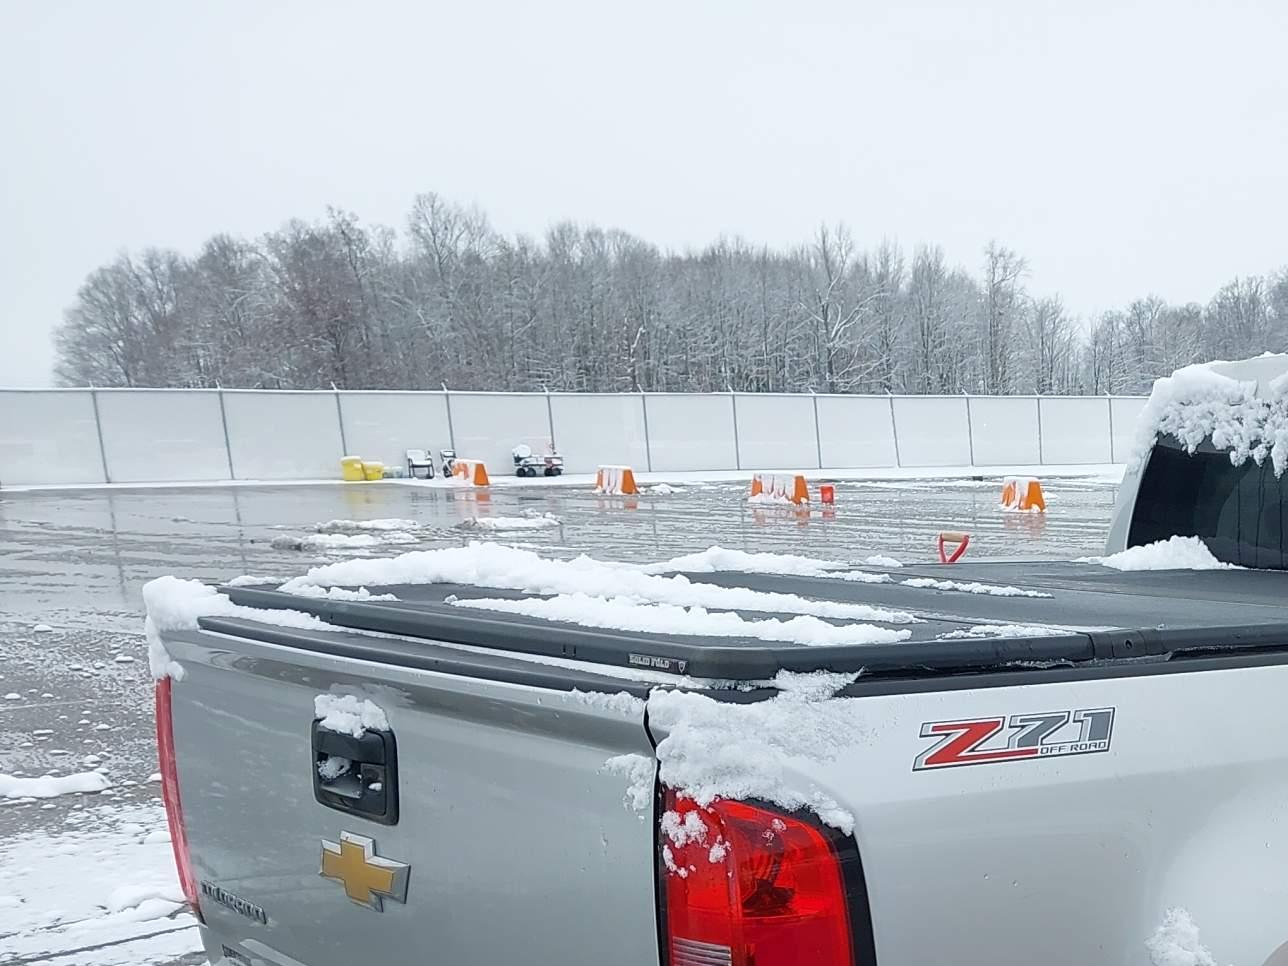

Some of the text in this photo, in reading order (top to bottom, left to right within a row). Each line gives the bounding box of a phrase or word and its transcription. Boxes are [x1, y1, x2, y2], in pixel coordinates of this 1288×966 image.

[912, 707, 1115, 771] Z71
[1040, 741, 1107, 755] OFF ROAD
